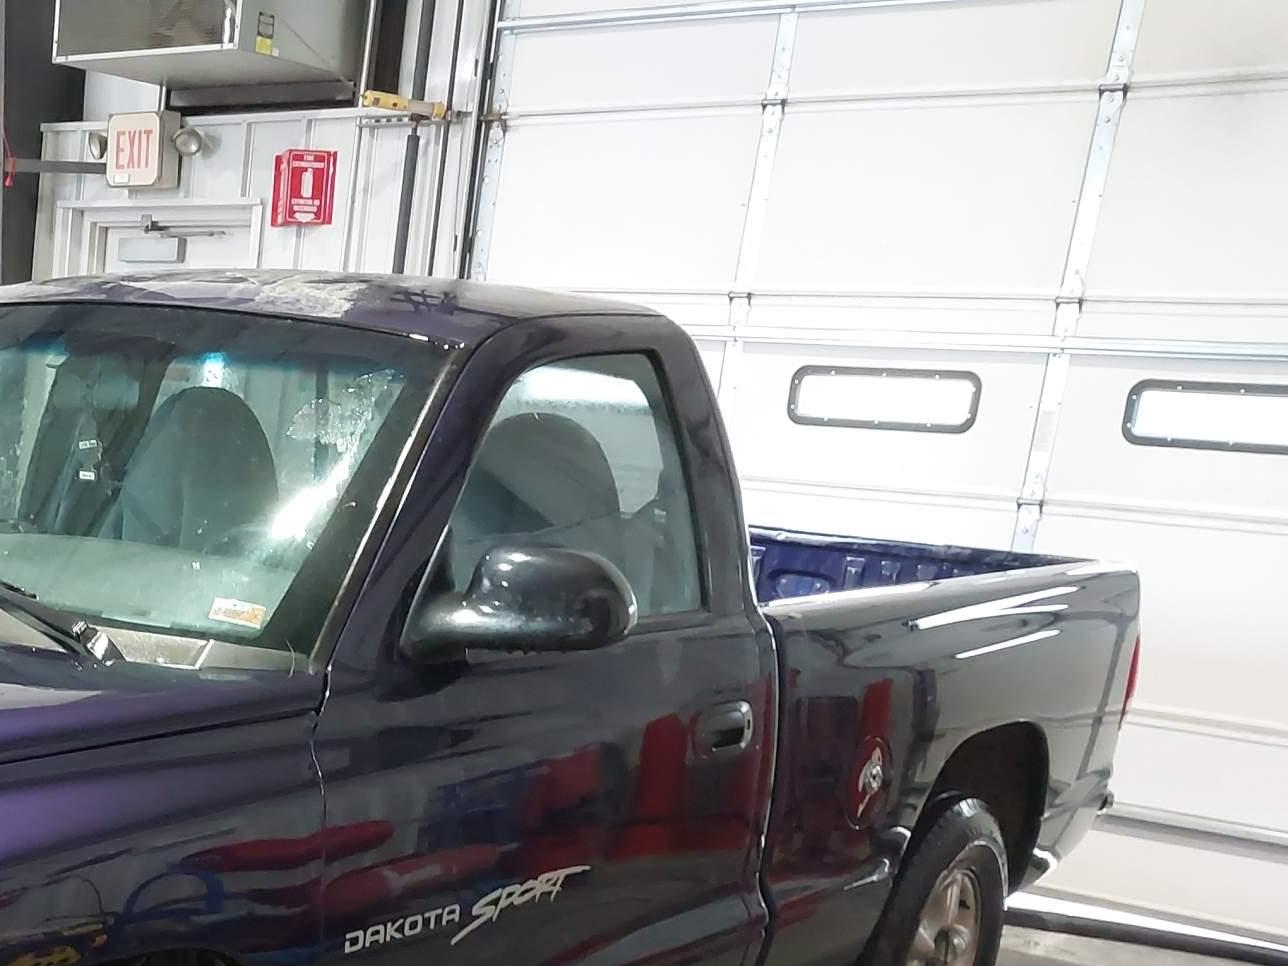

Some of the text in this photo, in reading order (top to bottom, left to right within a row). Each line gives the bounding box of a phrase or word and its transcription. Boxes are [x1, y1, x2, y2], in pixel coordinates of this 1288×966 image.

[115, 129, 153, 169] EXIT
[344, 864, 592, 954] DAKOTA SPORT
